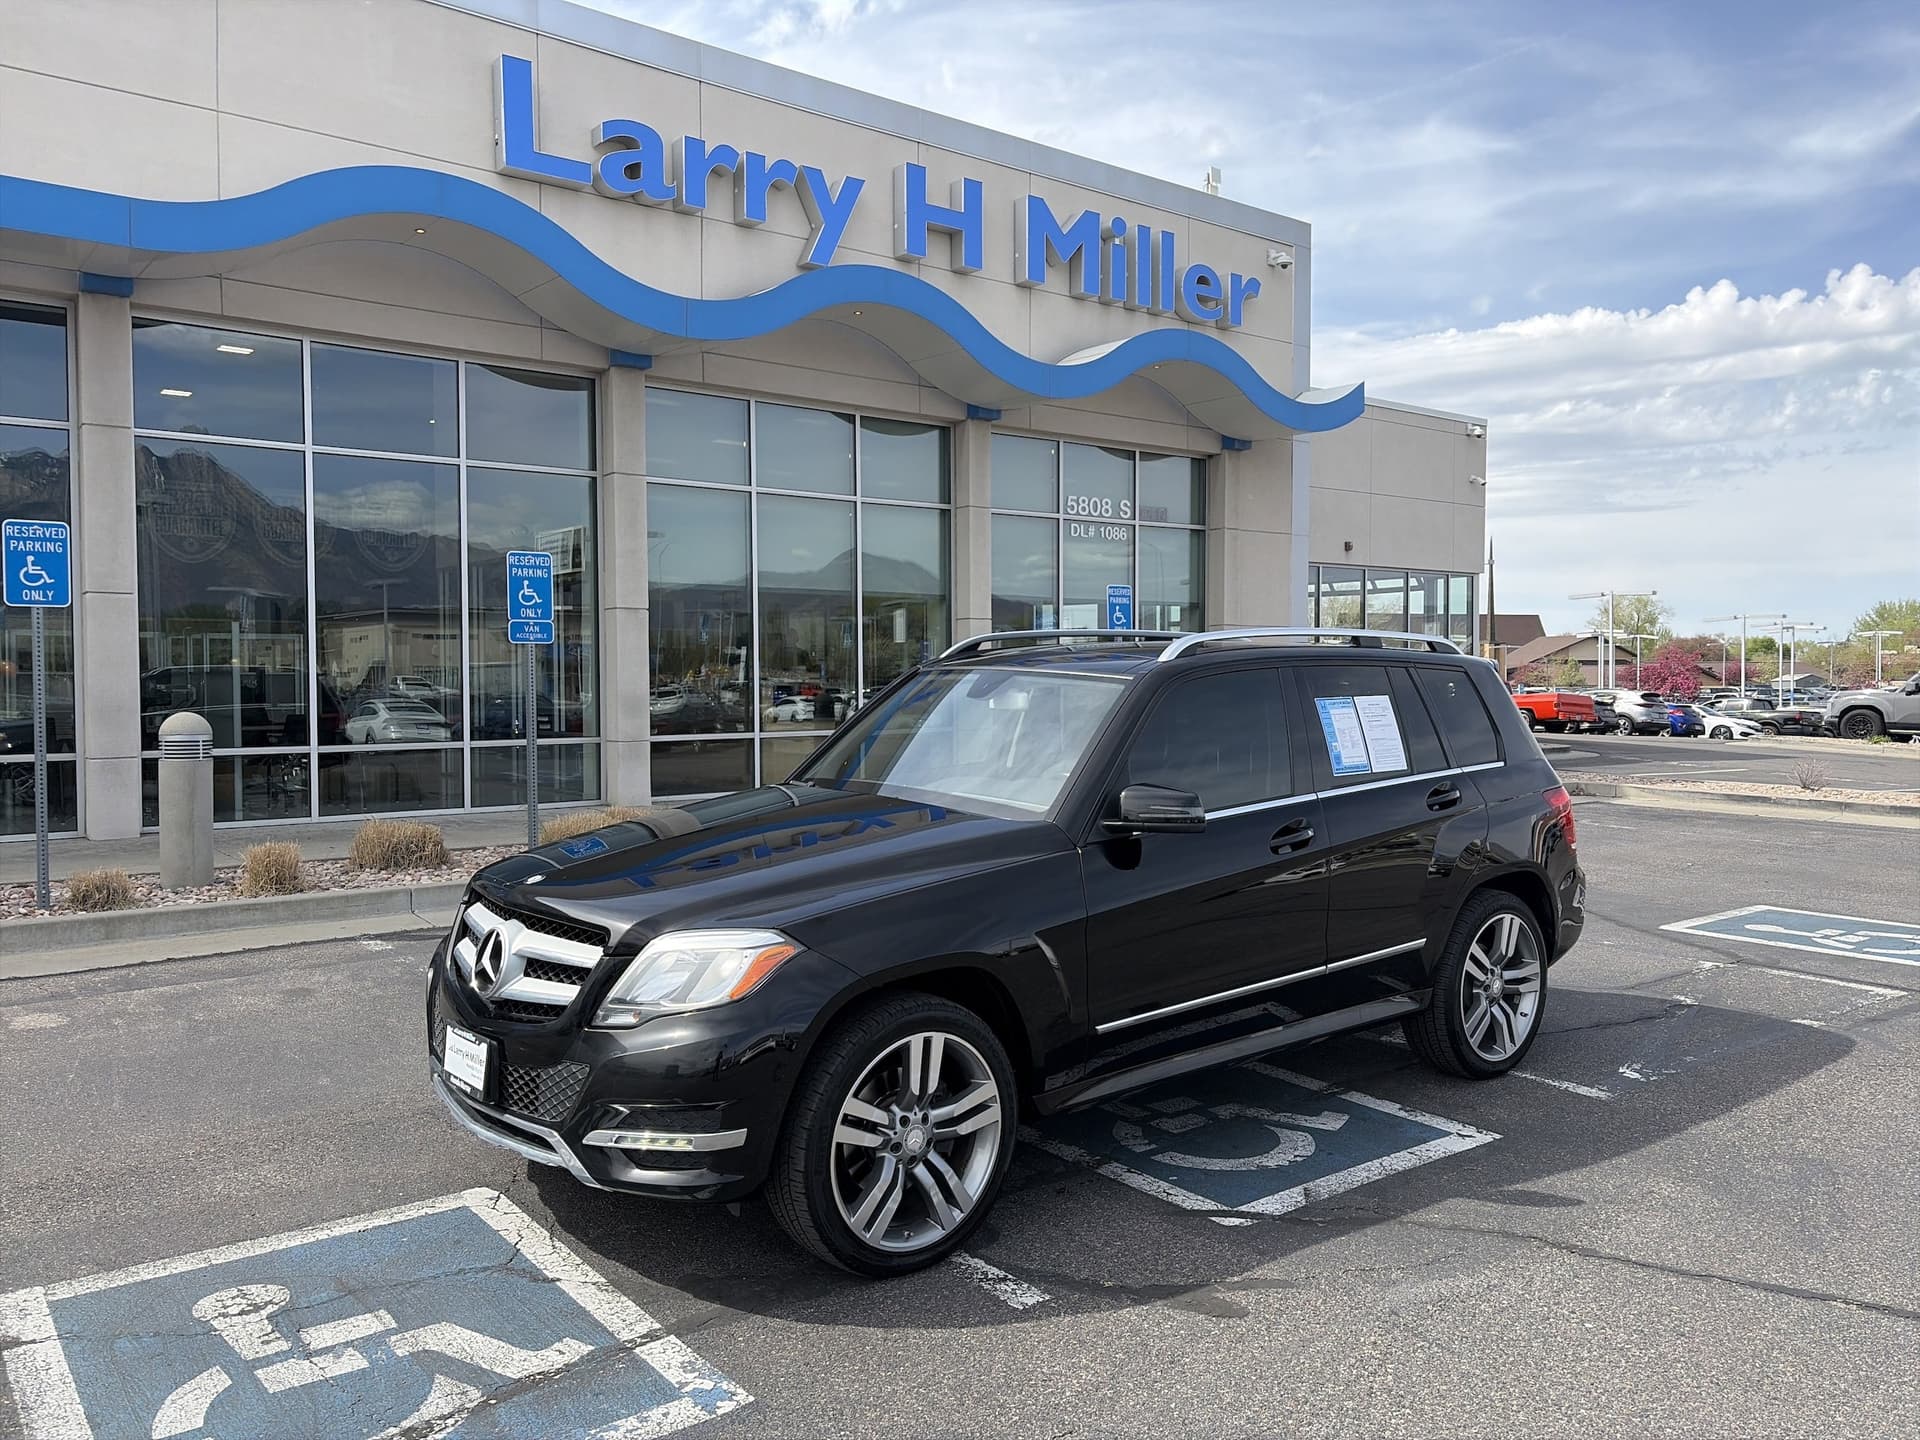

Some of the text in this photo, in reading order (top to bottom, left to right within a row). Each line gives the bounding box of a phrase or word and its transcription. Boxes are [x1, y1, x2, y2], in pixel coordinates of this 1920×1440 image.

[498, 53, 1262, 329] Larry H Miller
[1066, 495, 1112, 517] 5808
[1120, 499, 1131, 519] S
[6, 525, 66, 538] RESERVED
[1070, 523, 1127, 541] DL# 1086
[10, 540, 63, 553] PARKING
[509, 555, 550, 567] RESERVED
[512, 567, 548, 578] PARKING
[22, 589, 54, 601] ONLY
[520, 608, 542, 617] ONLY
[523, 625, 539, 633] VAN
